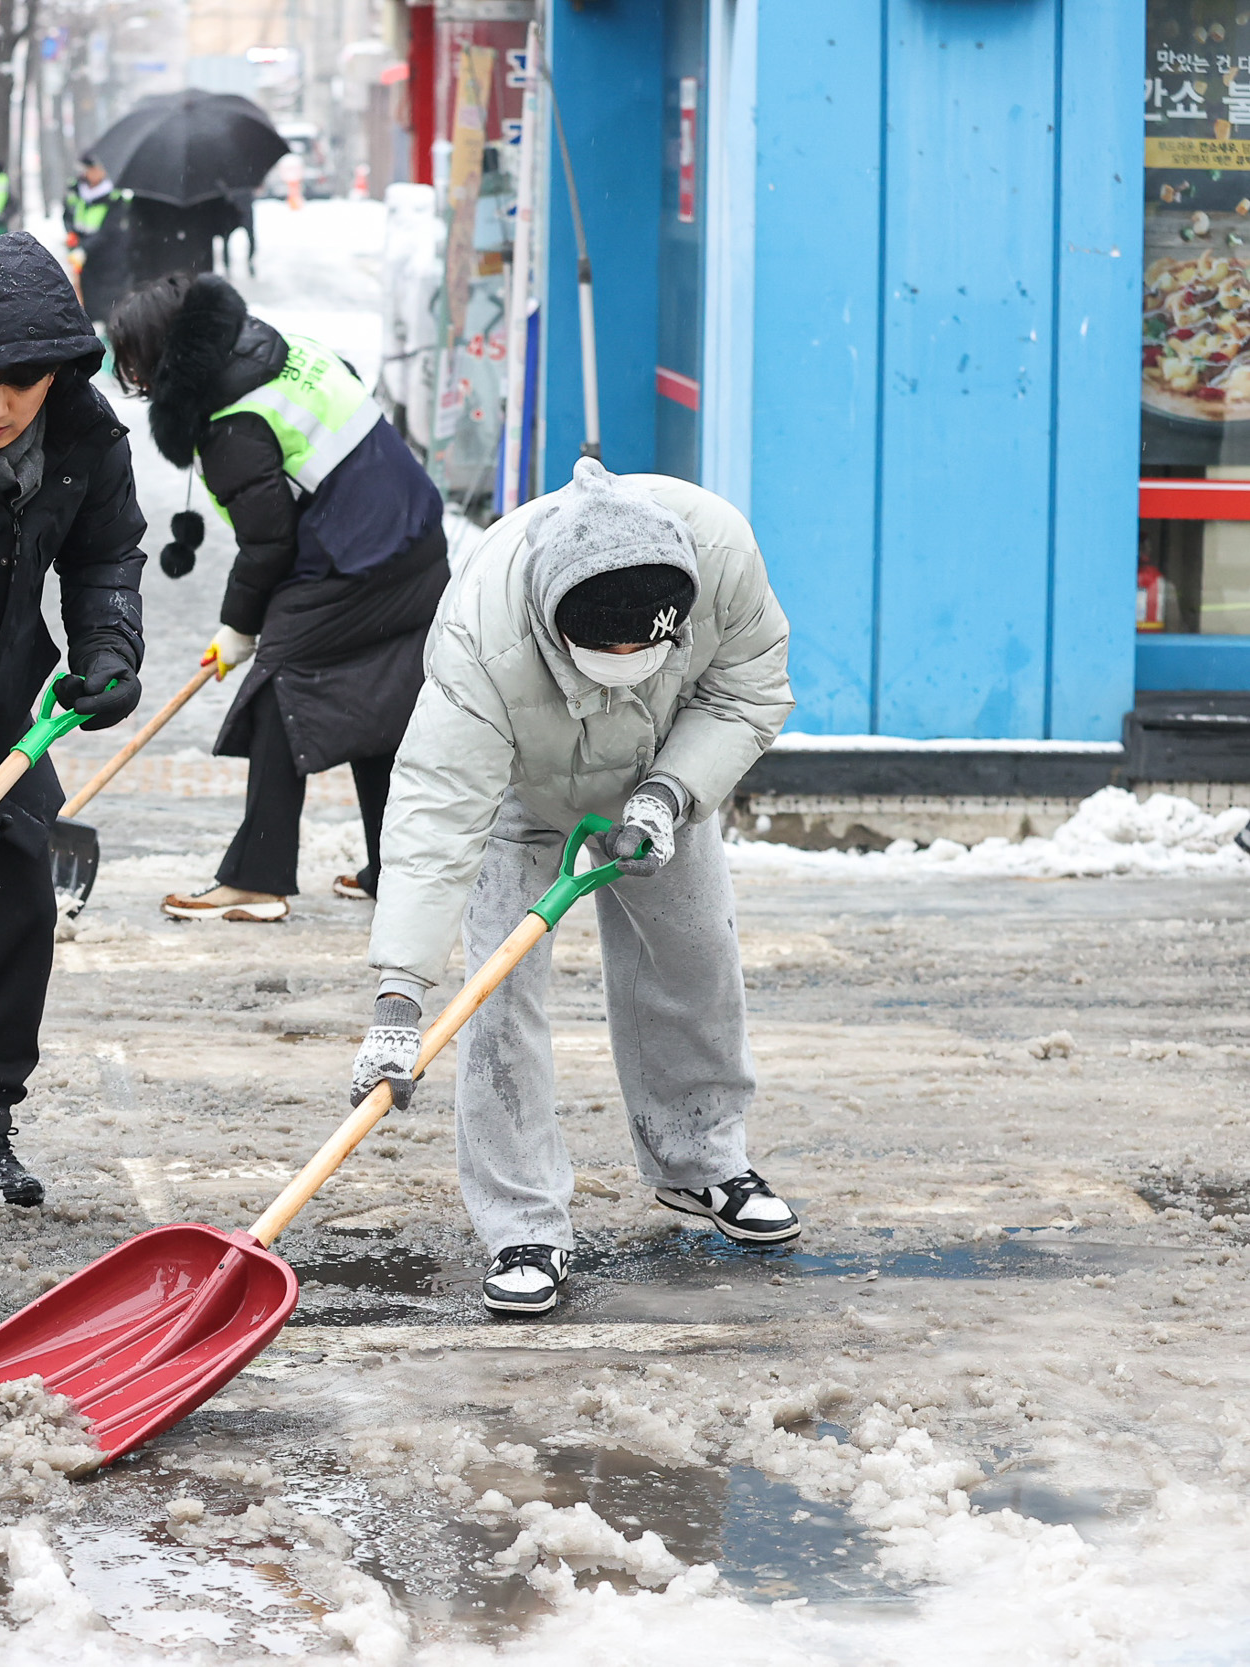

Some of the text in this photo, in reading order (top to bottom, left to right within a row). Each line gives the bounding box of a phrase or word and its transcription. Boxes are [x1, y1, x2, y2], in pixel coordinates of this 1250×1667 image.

[1156, 43, 1210, 74] 맛있는
[1216, 54, 1231, 74] 건
[649, 605, 678, 640] NY
